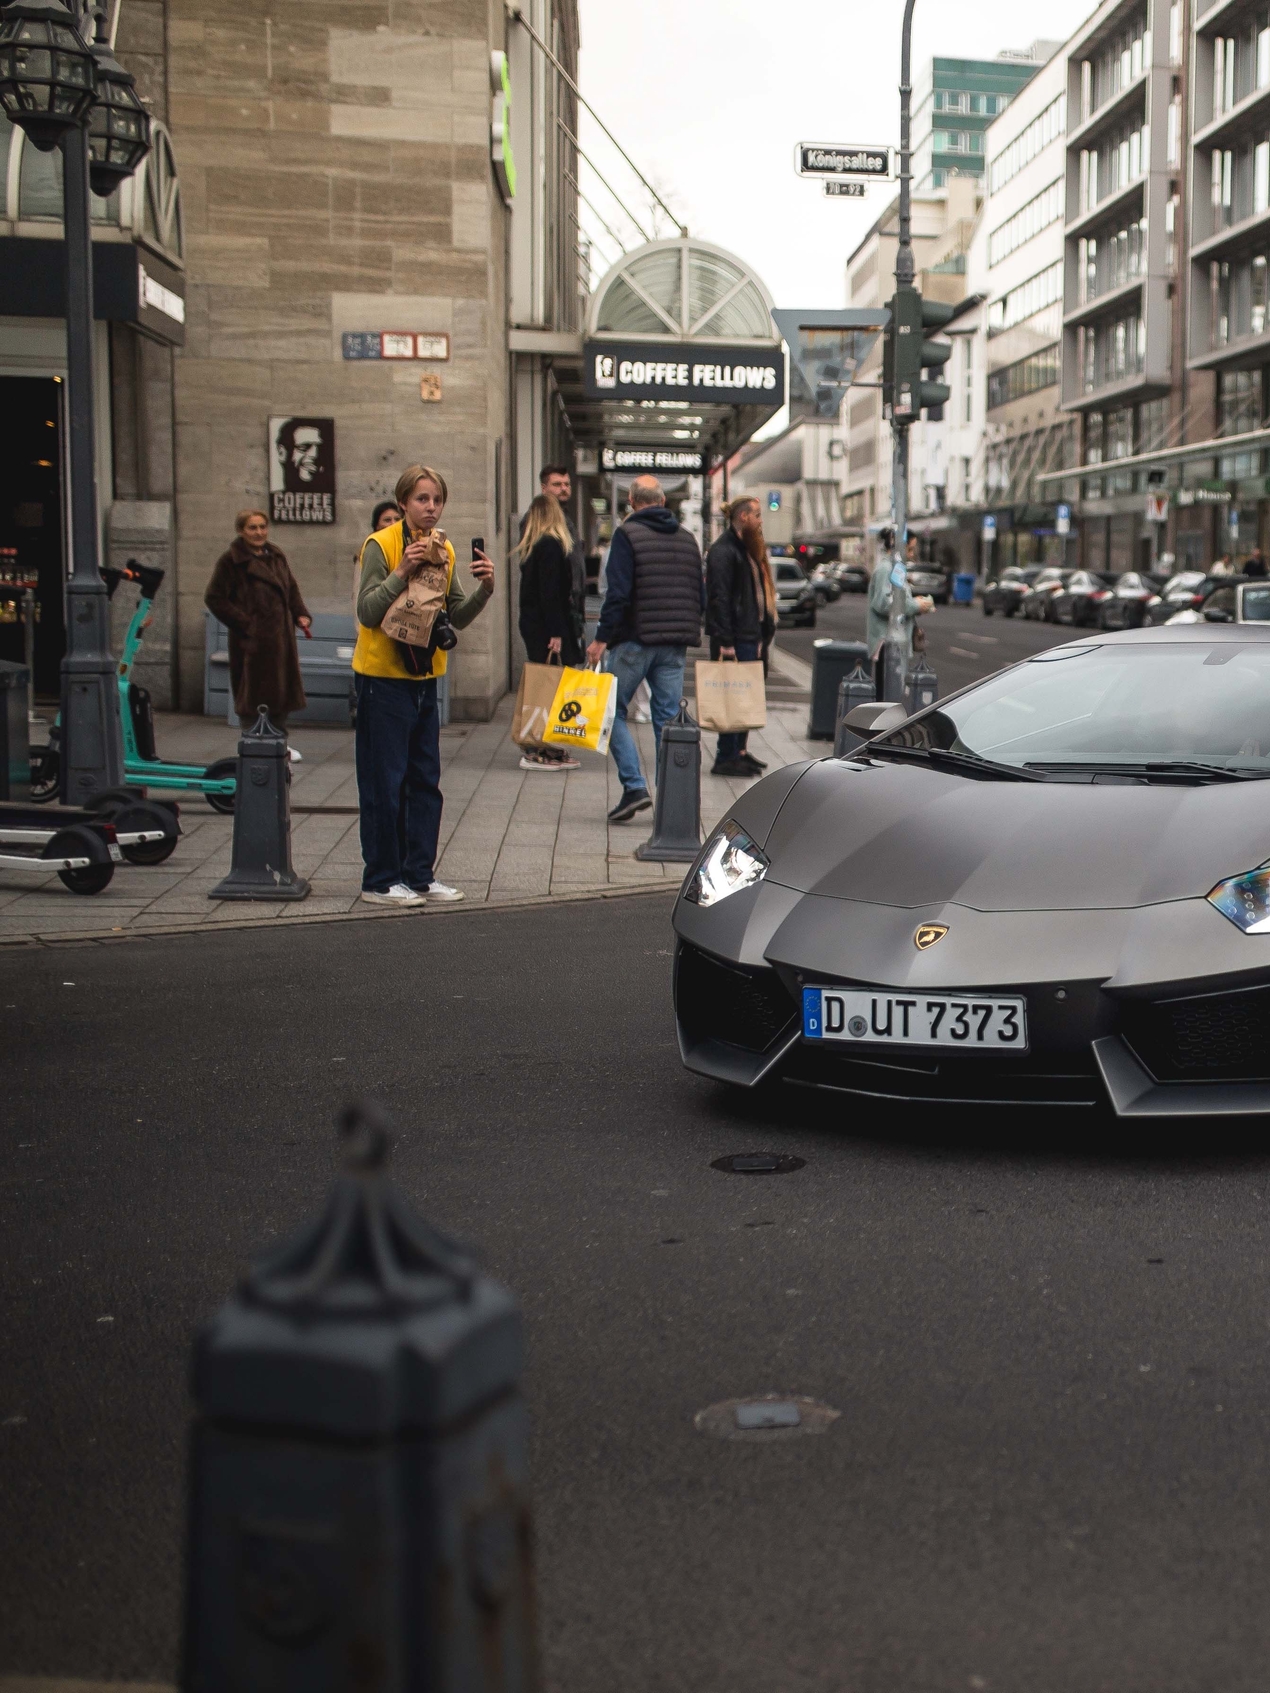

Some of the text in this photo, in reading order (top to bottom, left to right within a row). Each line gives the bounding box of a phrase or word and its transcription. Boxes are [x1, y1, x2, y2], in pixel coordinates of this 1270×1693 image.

[807, 149, 884, 171] Königsallee
[619, 360, 689, 386] COFFEE
[692, 363, 776, 390] FELLOWS
[615, 451, 702, 469] COFFEE FELLOWS
[274, 492, 333, 508] COFFEE
[274, 507, 334, 522] FELLOWS
[553, 725, 586, 738] HINKEL
[824, 996, 1019, 1042] D UT 7373
